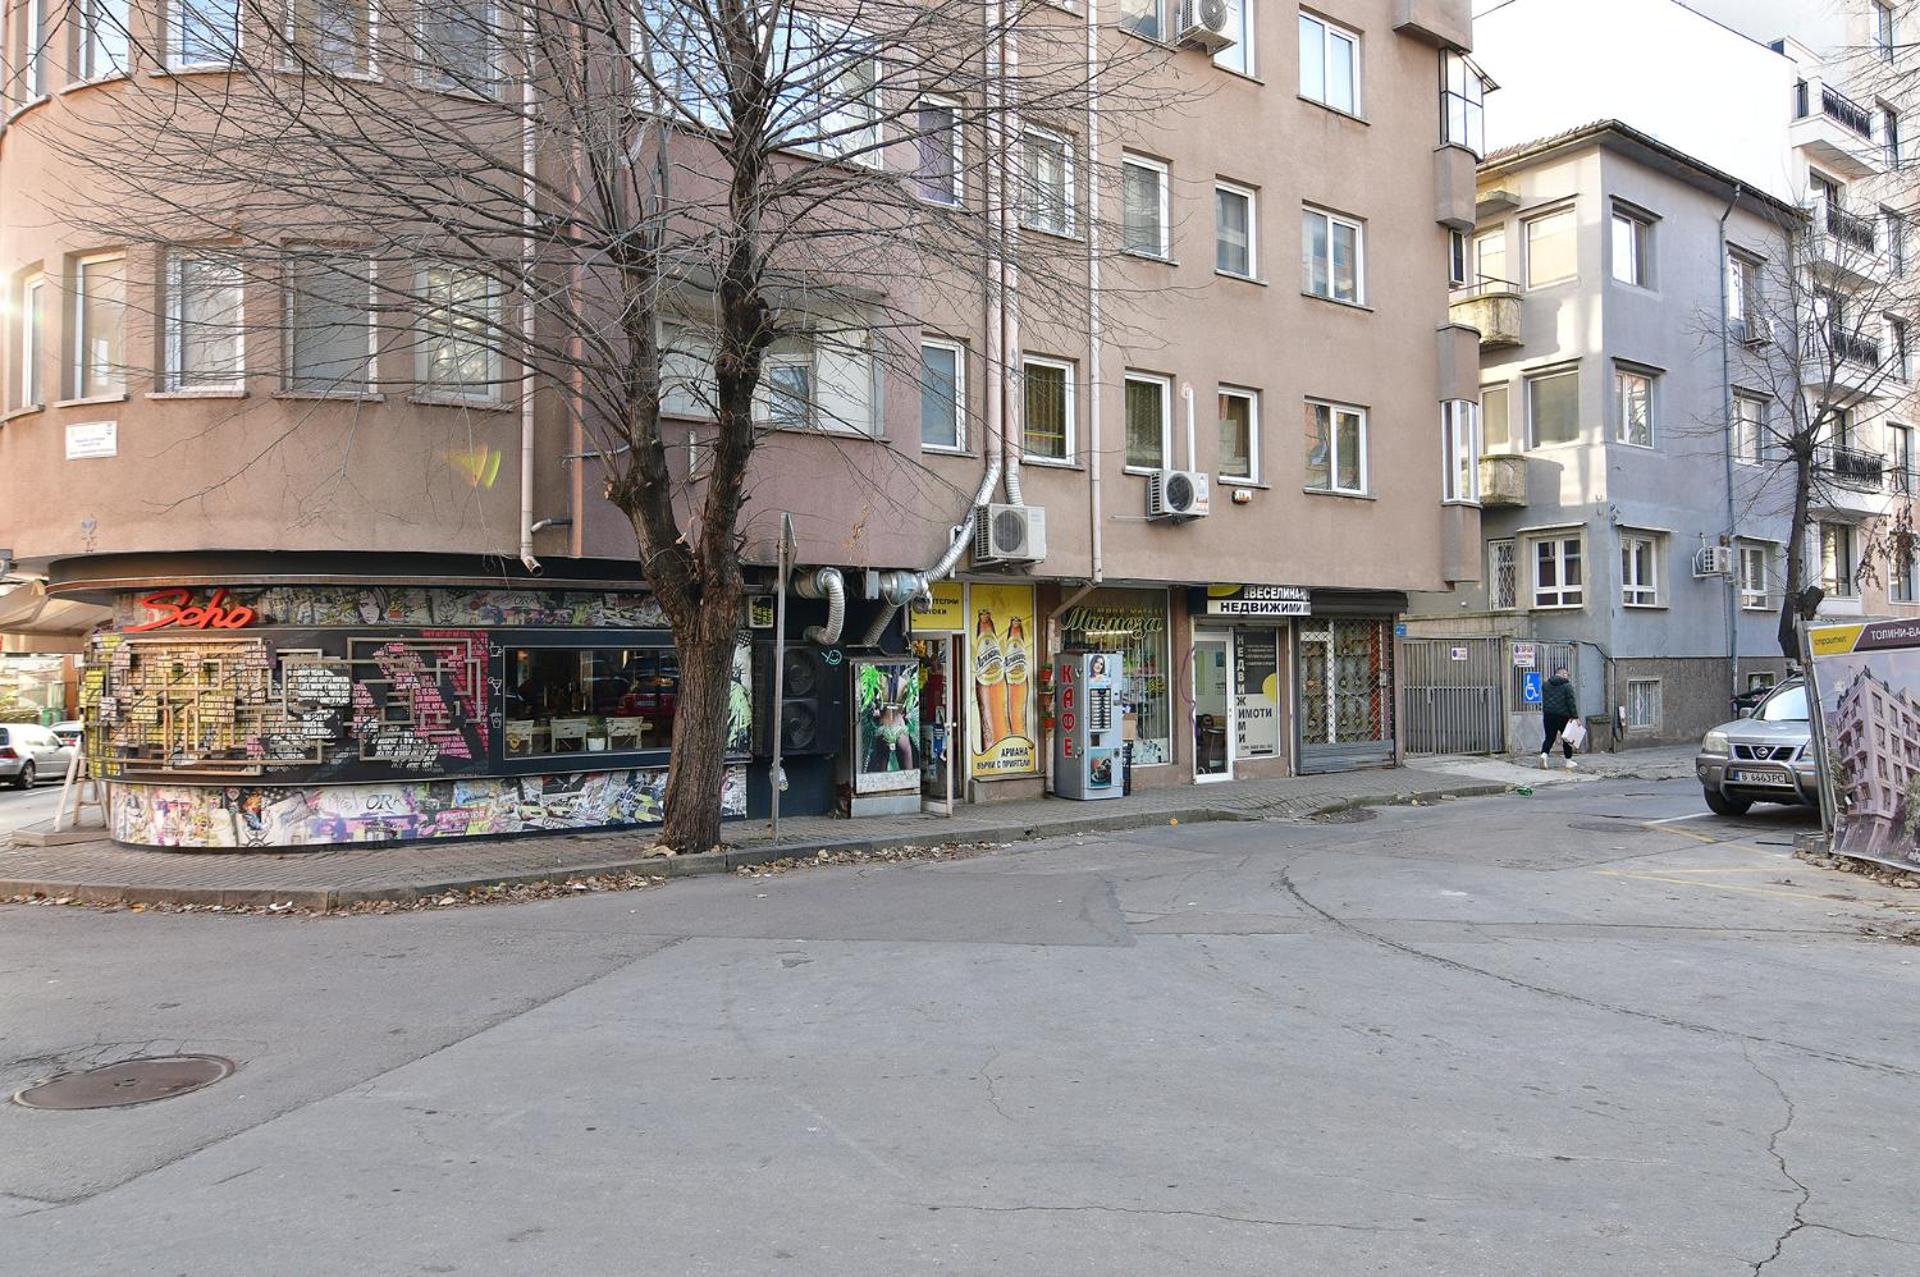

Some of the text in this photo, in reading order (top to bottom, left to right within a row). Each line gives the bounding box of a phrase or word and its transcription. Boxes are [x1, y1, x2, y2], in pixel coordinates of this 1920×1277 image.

[122, 587, 256, 632] Soho
[1060, 607, 1163, 639] Мимоза
[1221, 602, 1302, 614] НЕДВИЖИМИ
[1237, 635, 1246, 743] НЕДВИЖИМИ
[1060, 664, 1075, 758] КАФЕ
[1238, 708, 1272, 719] ИМОТИ
